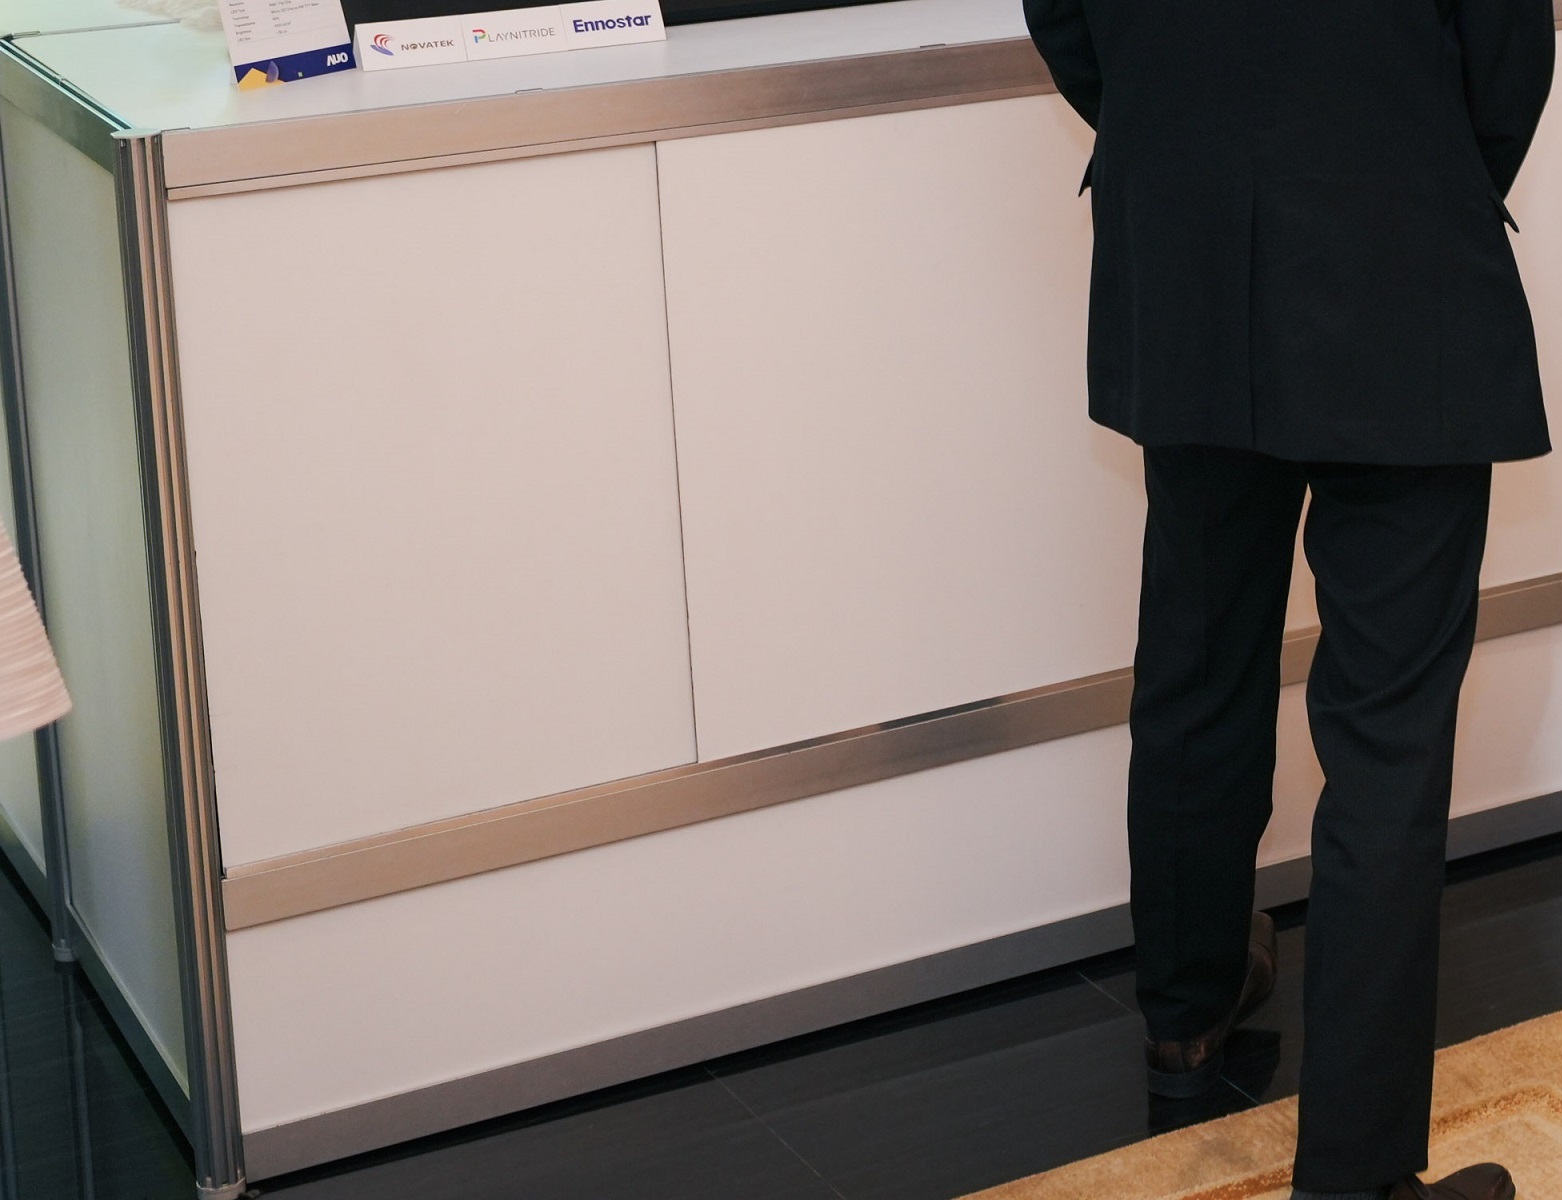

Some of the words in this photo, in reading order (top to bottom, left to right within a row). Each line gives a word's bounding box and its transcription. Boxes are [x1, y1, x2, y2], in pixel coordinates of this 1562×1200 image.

[573, 14, 652, 33] Ennostar
[472, 27, 556, 43] PLAYNITRIDE
[401, 39, 454, 51] NOVATEK
[326, 52, 349, 66] AUO
